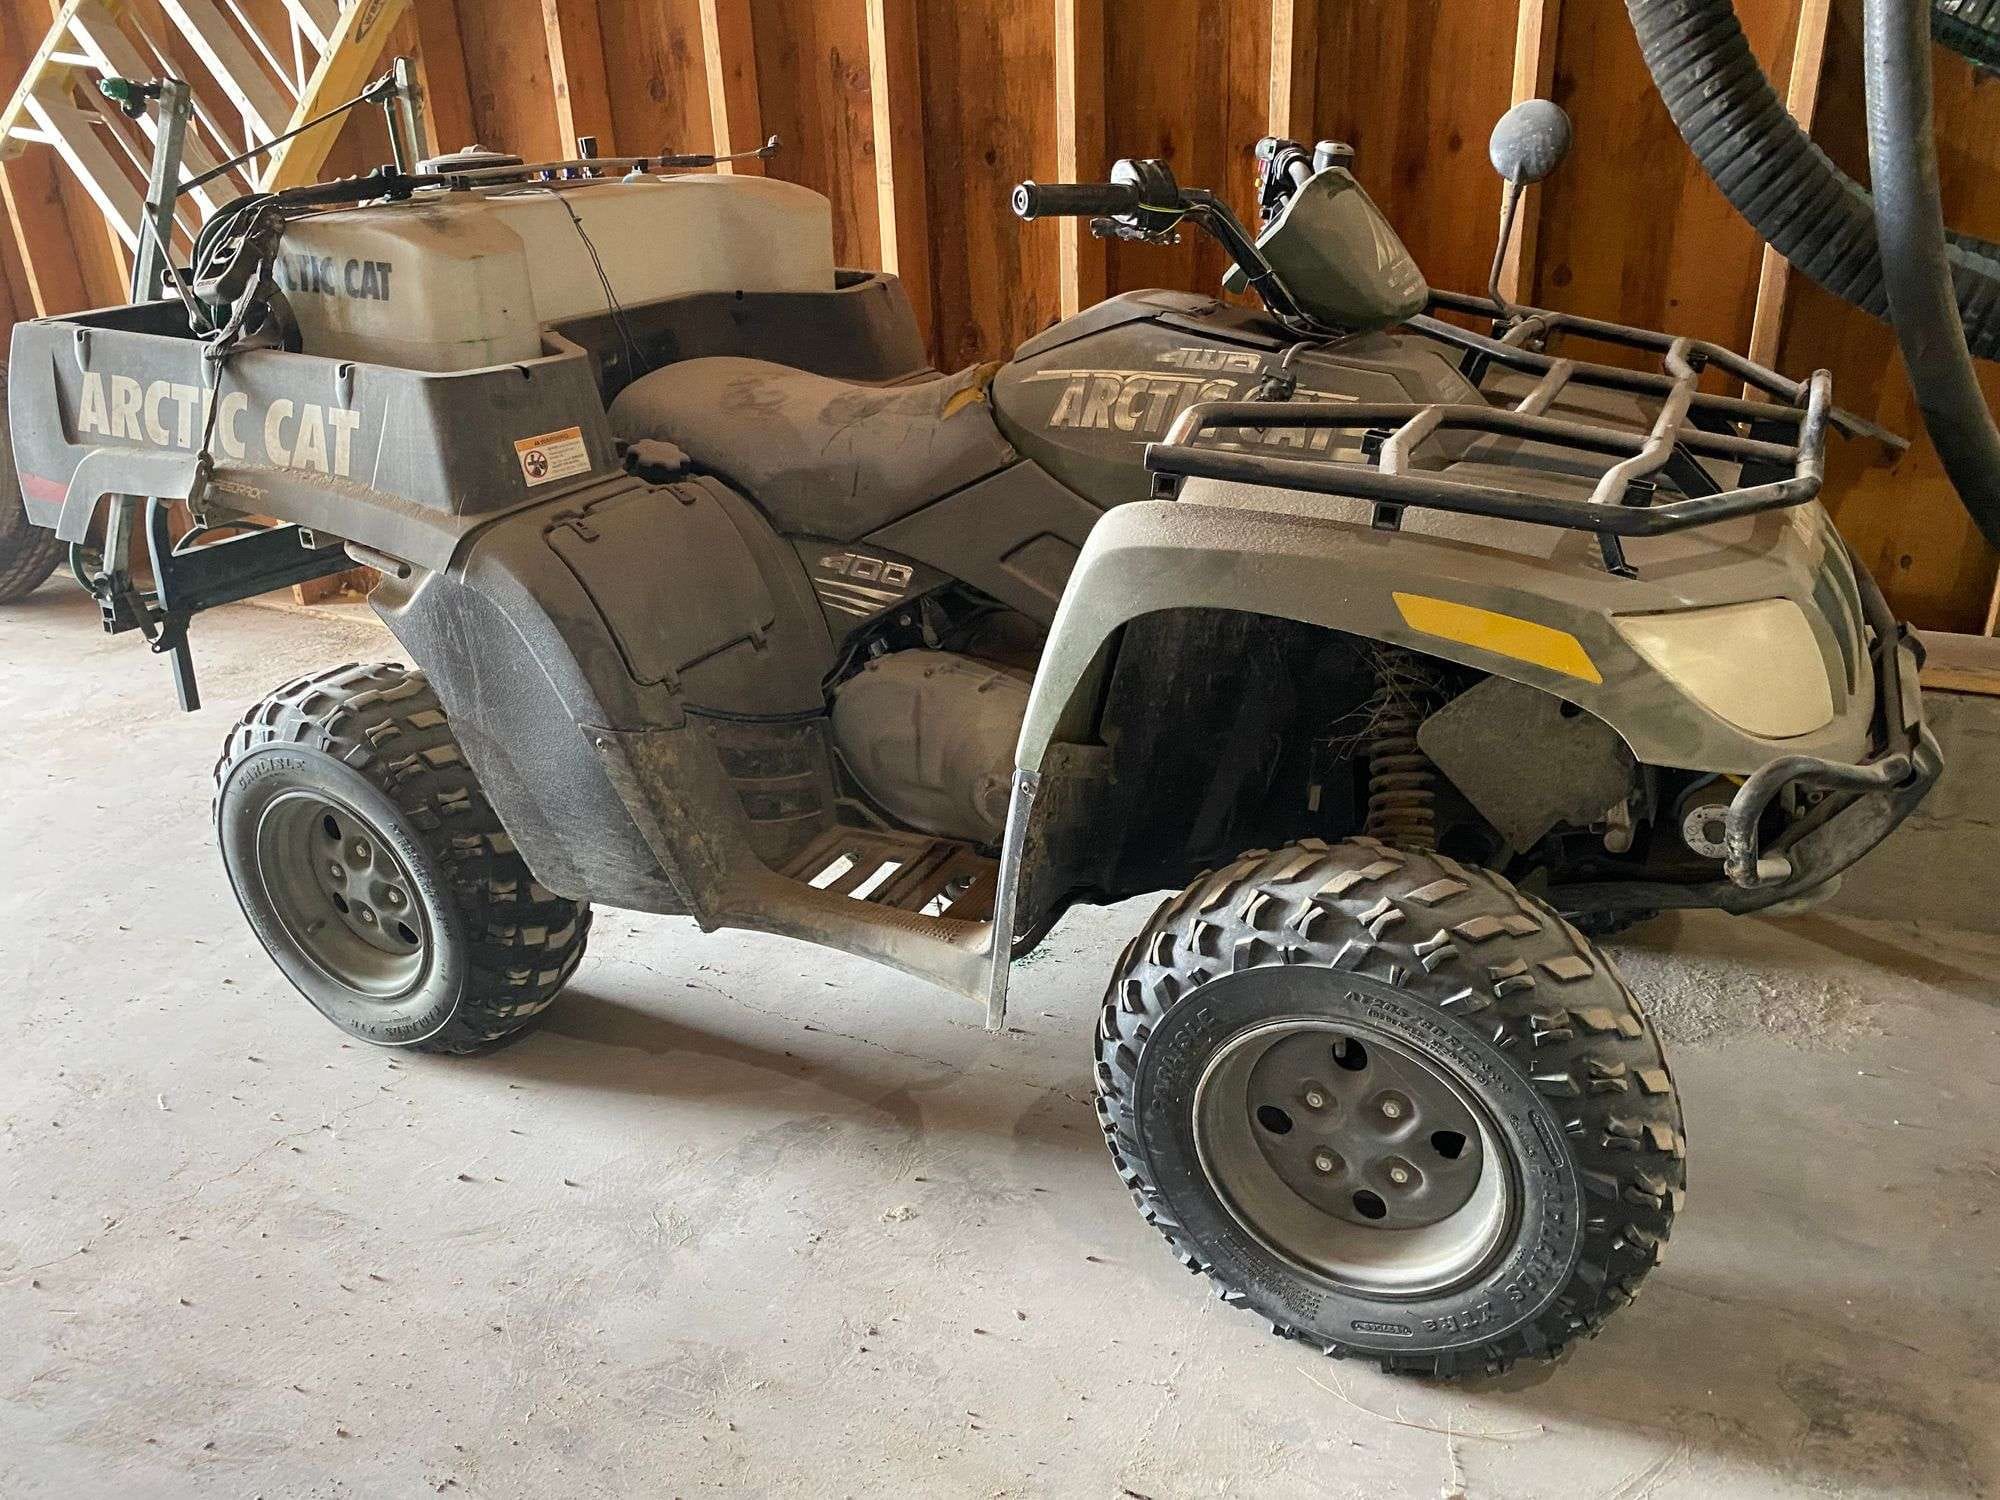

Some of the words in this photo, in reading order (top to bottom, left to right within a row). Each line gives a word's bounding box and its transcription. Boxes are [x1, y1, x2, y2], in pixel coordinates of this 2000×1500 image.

[282, 252, 336, 296] CTIC
[344, 258, 393, 301] CAT
[77, 371, 249, 459] ARCTIC
[264, 398, 361, 477] CAT
[820, 552, 914, 588] 400
